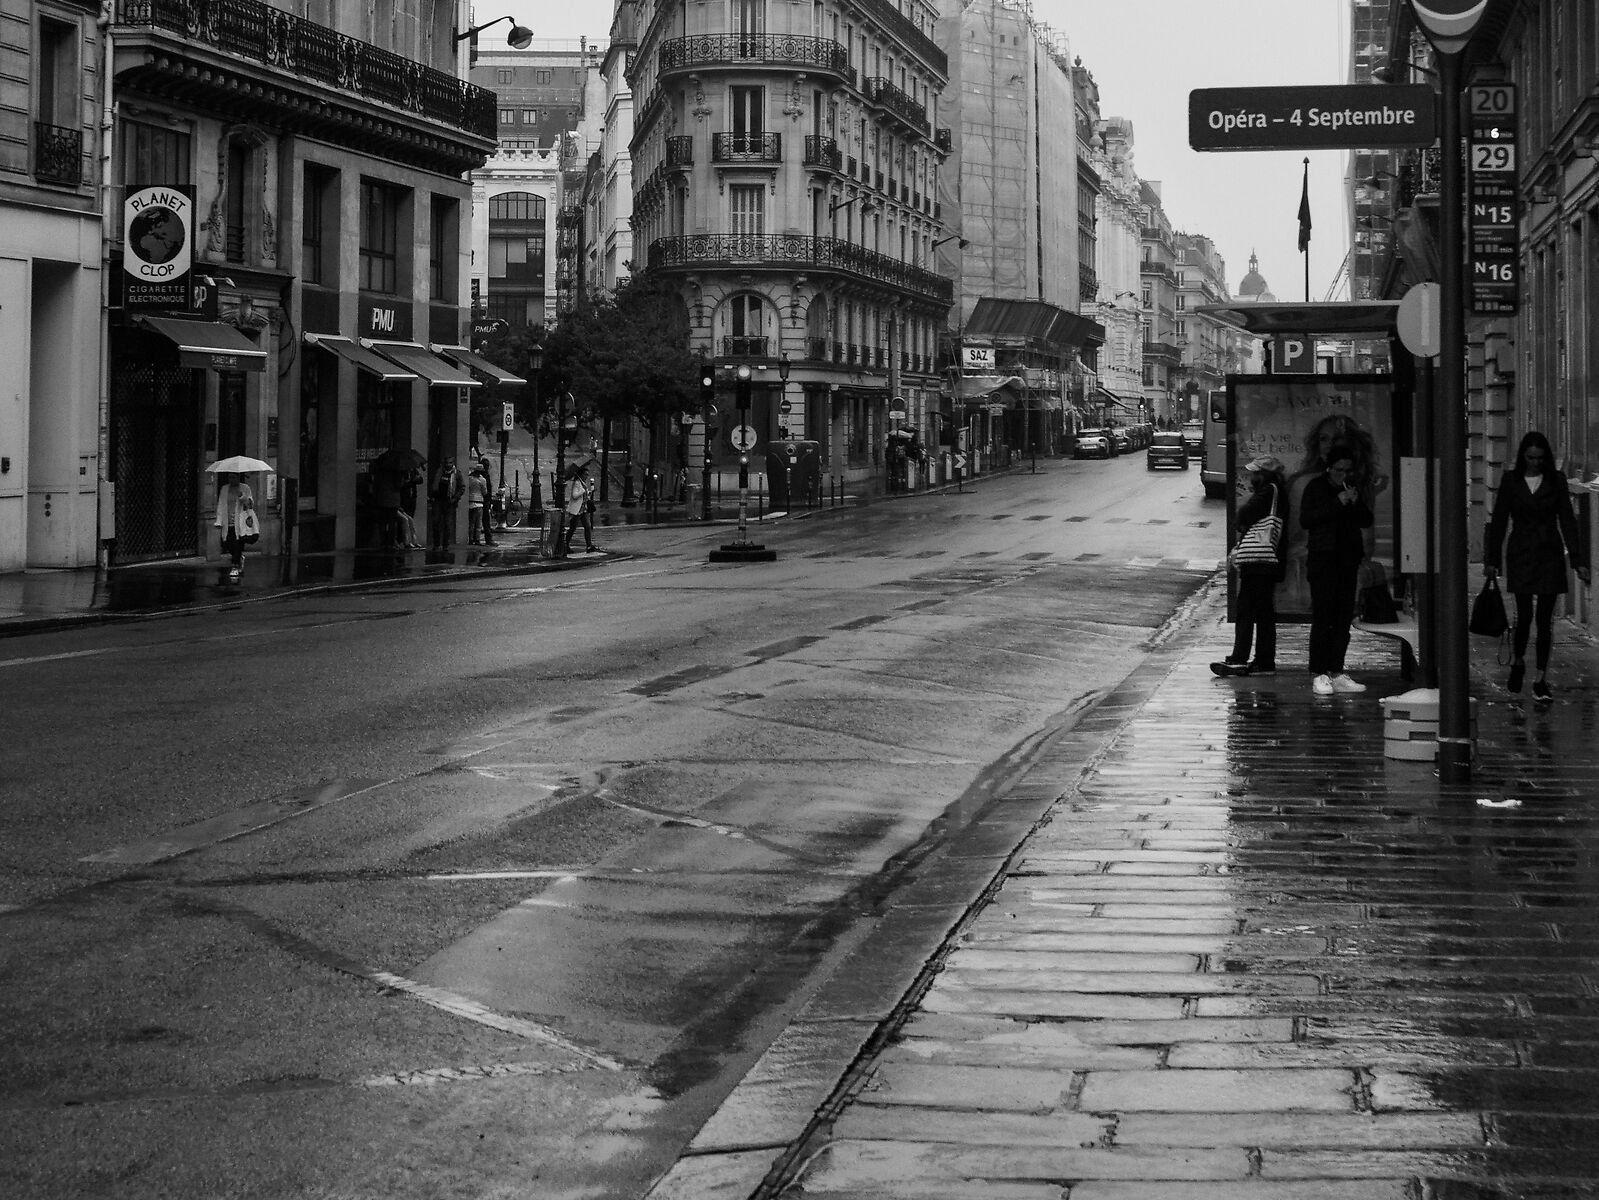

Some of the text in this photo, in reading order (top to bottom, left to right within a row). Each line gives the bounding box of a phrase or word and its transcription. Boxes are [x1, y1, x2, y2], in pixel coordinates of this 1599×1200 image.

[1477, 90, 1508, 111] 20
[1208, 109, 1267, 133] Opéra
[1289, 109, 1302, 127] 4
[1308, 106, 1415, 130] Septembre
[1490, 127, 1500, 139] 6
[1477, 146, 1509, 169] 29
[131, 192, 186, 212] PLANET
[1474, 204, 1512, 224] N15
[140, 263, 175, 277] CLOP
[1474, 261, 1513, 281] N16
[128, 285, 186, 294] CIGARETTE
[372, 307, 395, 332] PMU
[474, 325, 493, 333] PMU
[970, 349, 989, 361] SAZ
[1284, 340, 1304, 367] P
